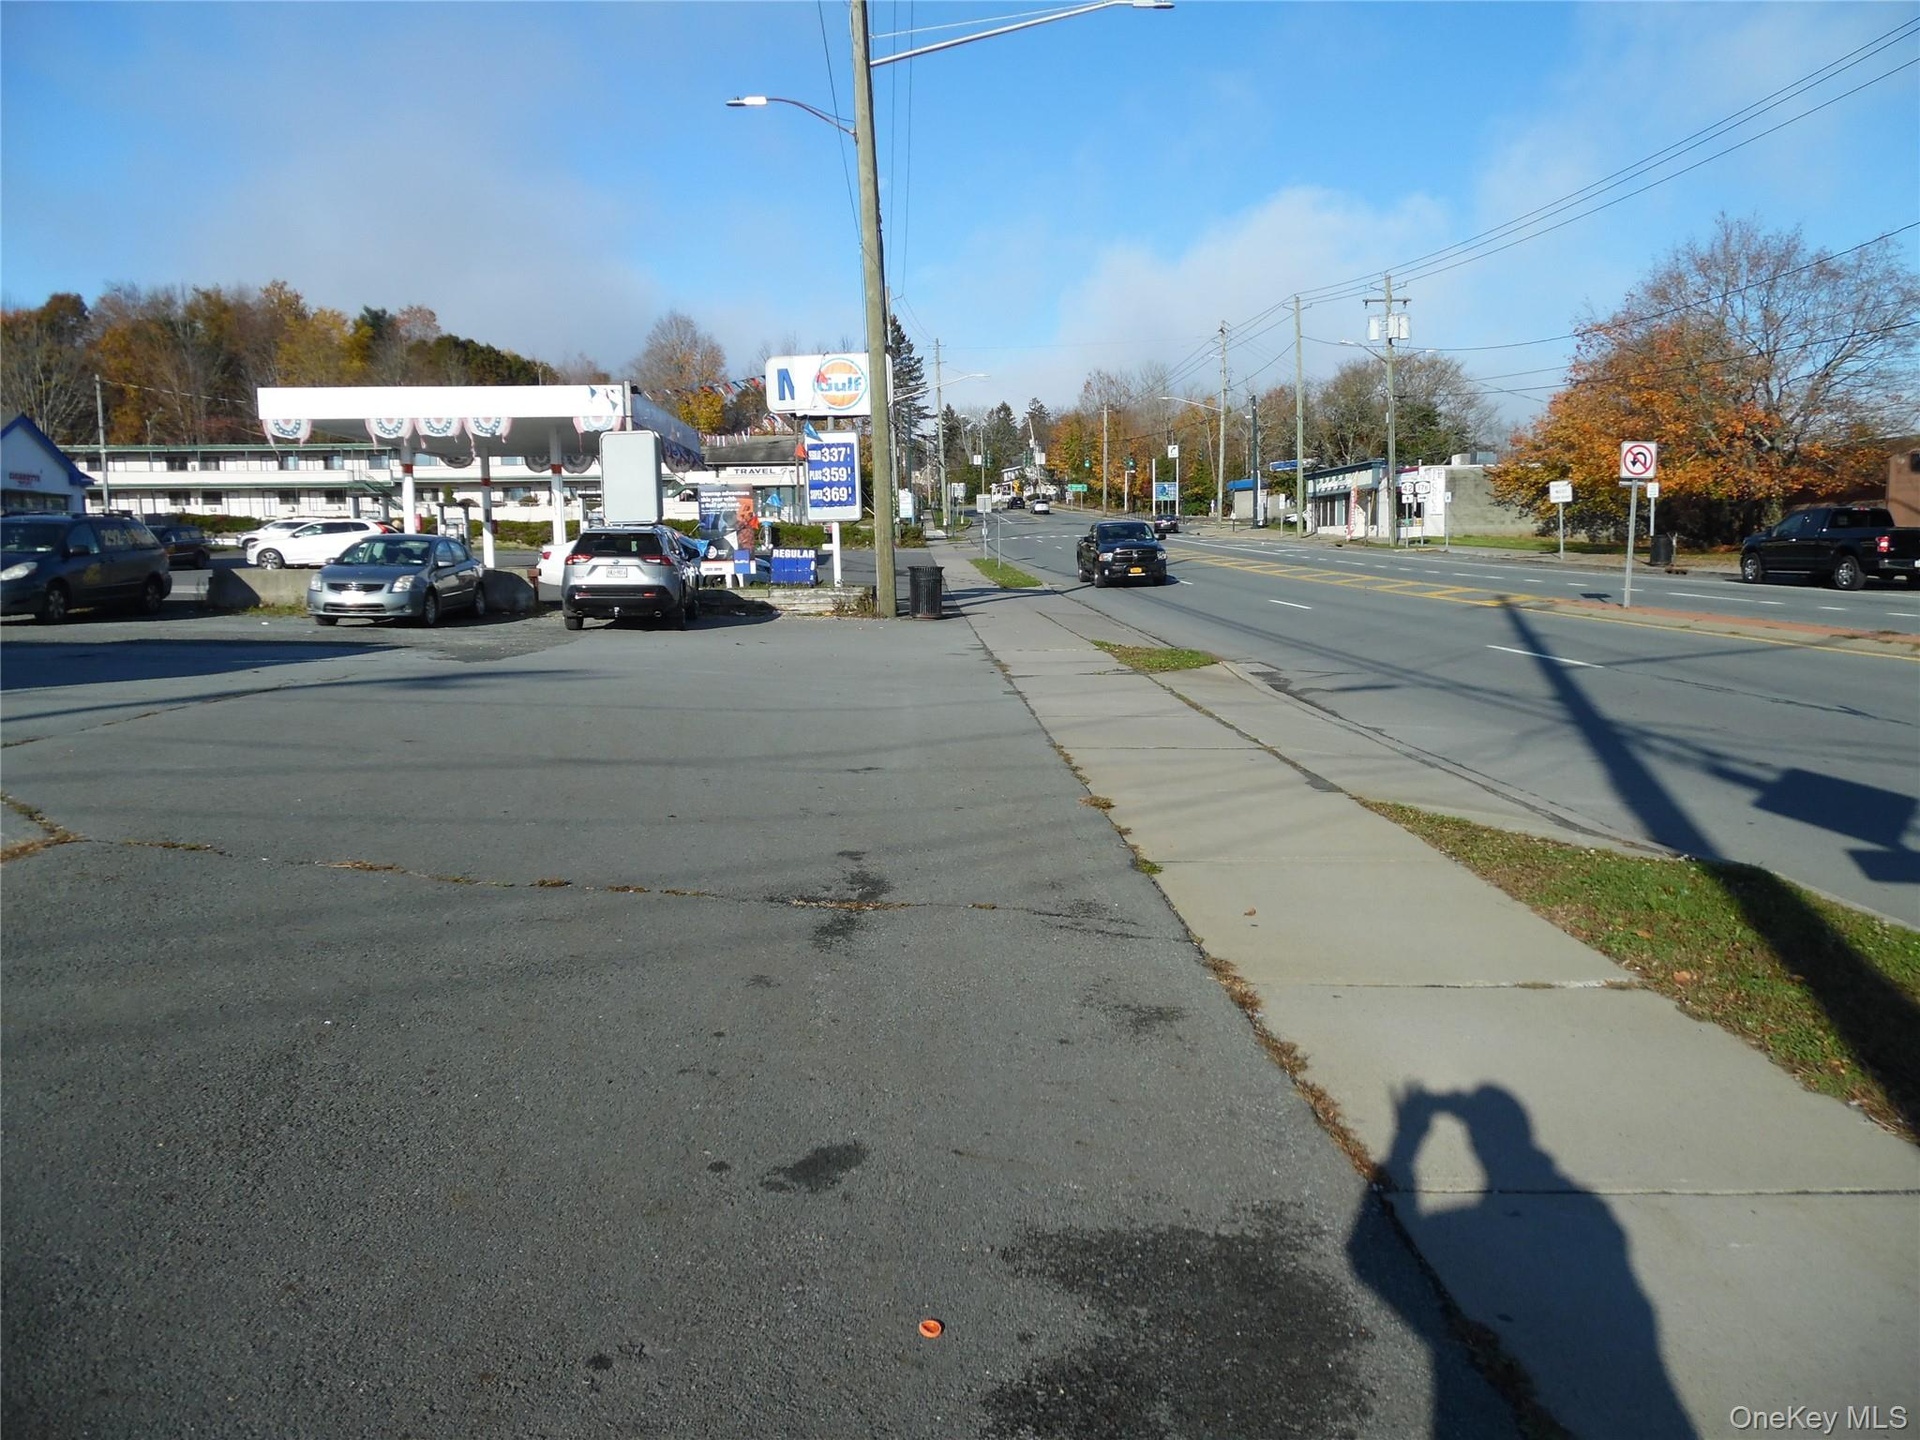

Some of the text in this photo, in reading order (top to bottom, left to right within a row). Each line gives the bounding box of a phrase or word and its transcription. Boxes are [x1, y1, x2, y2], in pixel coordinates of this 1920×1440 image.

[817, 376, 862, 392] Gulf
[821, 447, 846, 462] 337
[822, 467, 847, 482] 359
[822, 487, 848, 502] 369
[772, 549, 816, 559] REGULAR
